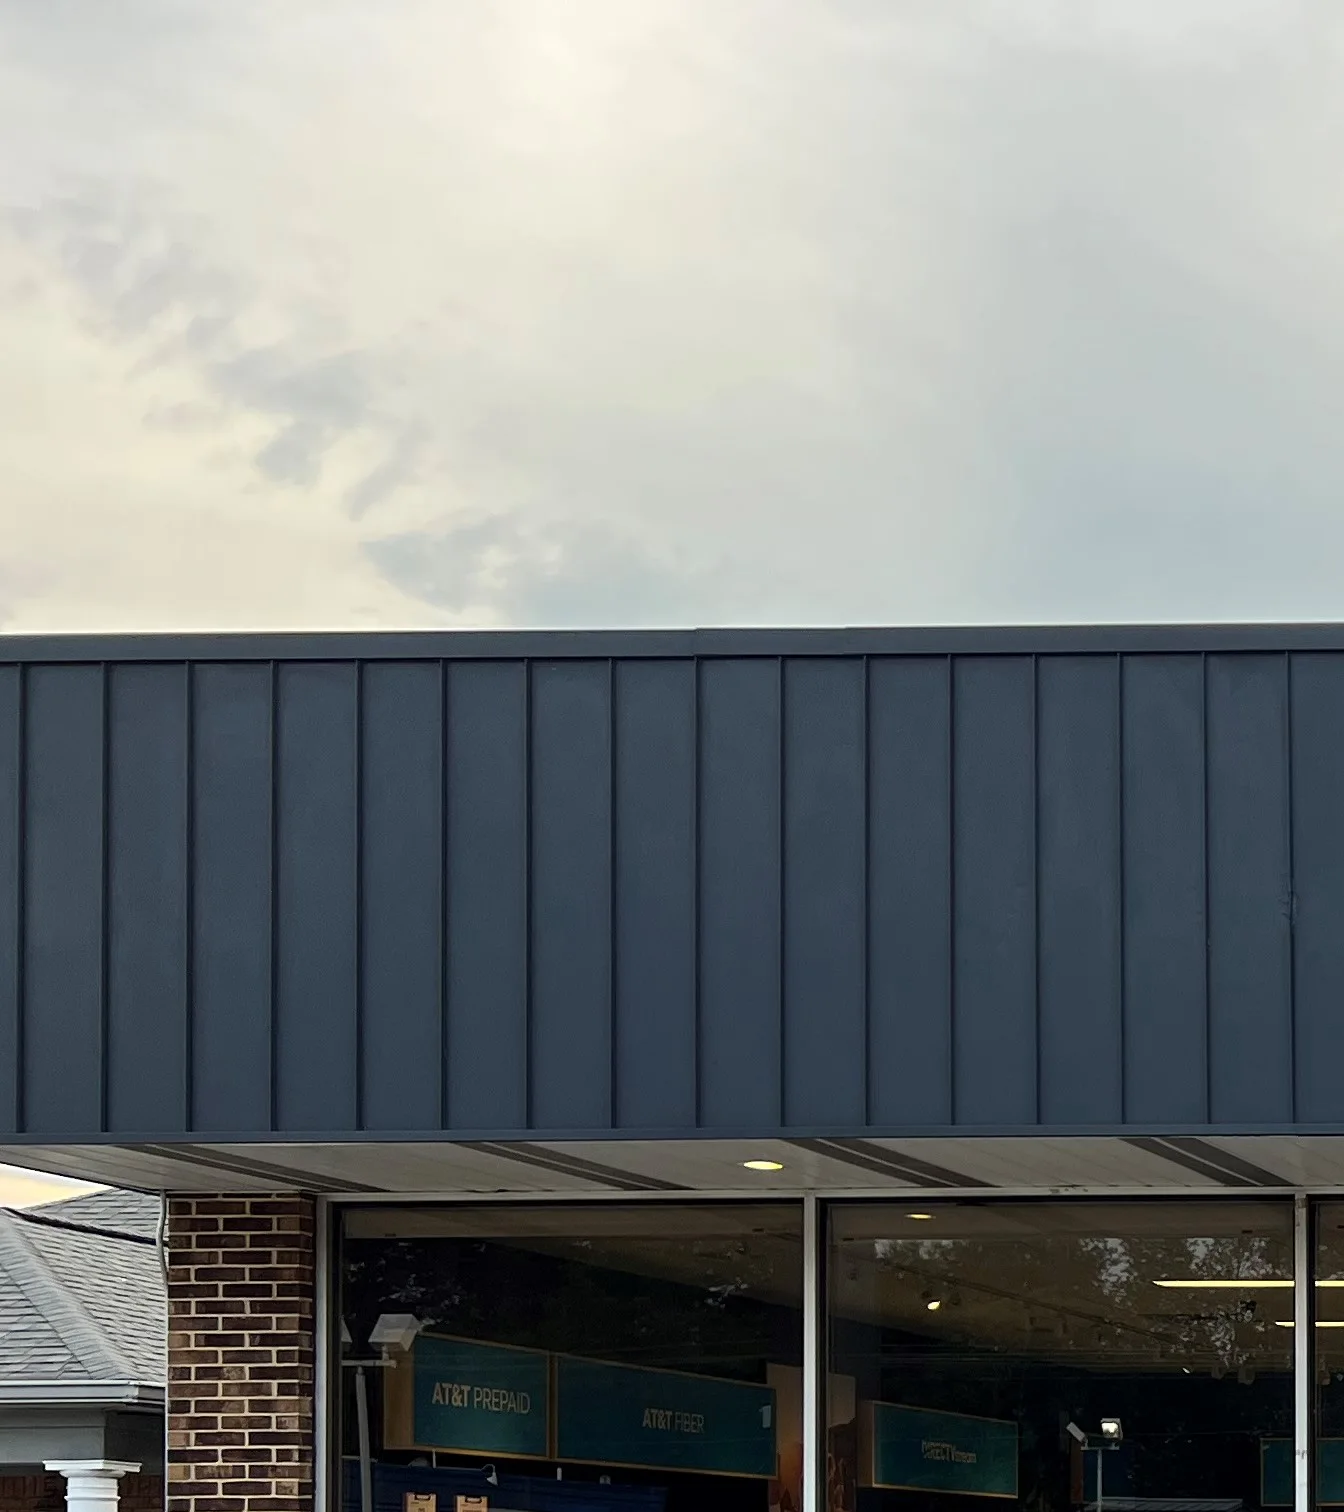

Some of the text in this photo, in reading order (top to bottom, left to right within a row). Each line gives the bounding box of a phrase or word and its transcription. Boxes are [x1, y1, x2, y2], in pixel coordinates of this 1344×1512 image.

[432, 1381, 532, 1415] AT&T PREPAID
[642, 1407, 706, 1434] AT&T FIBER
